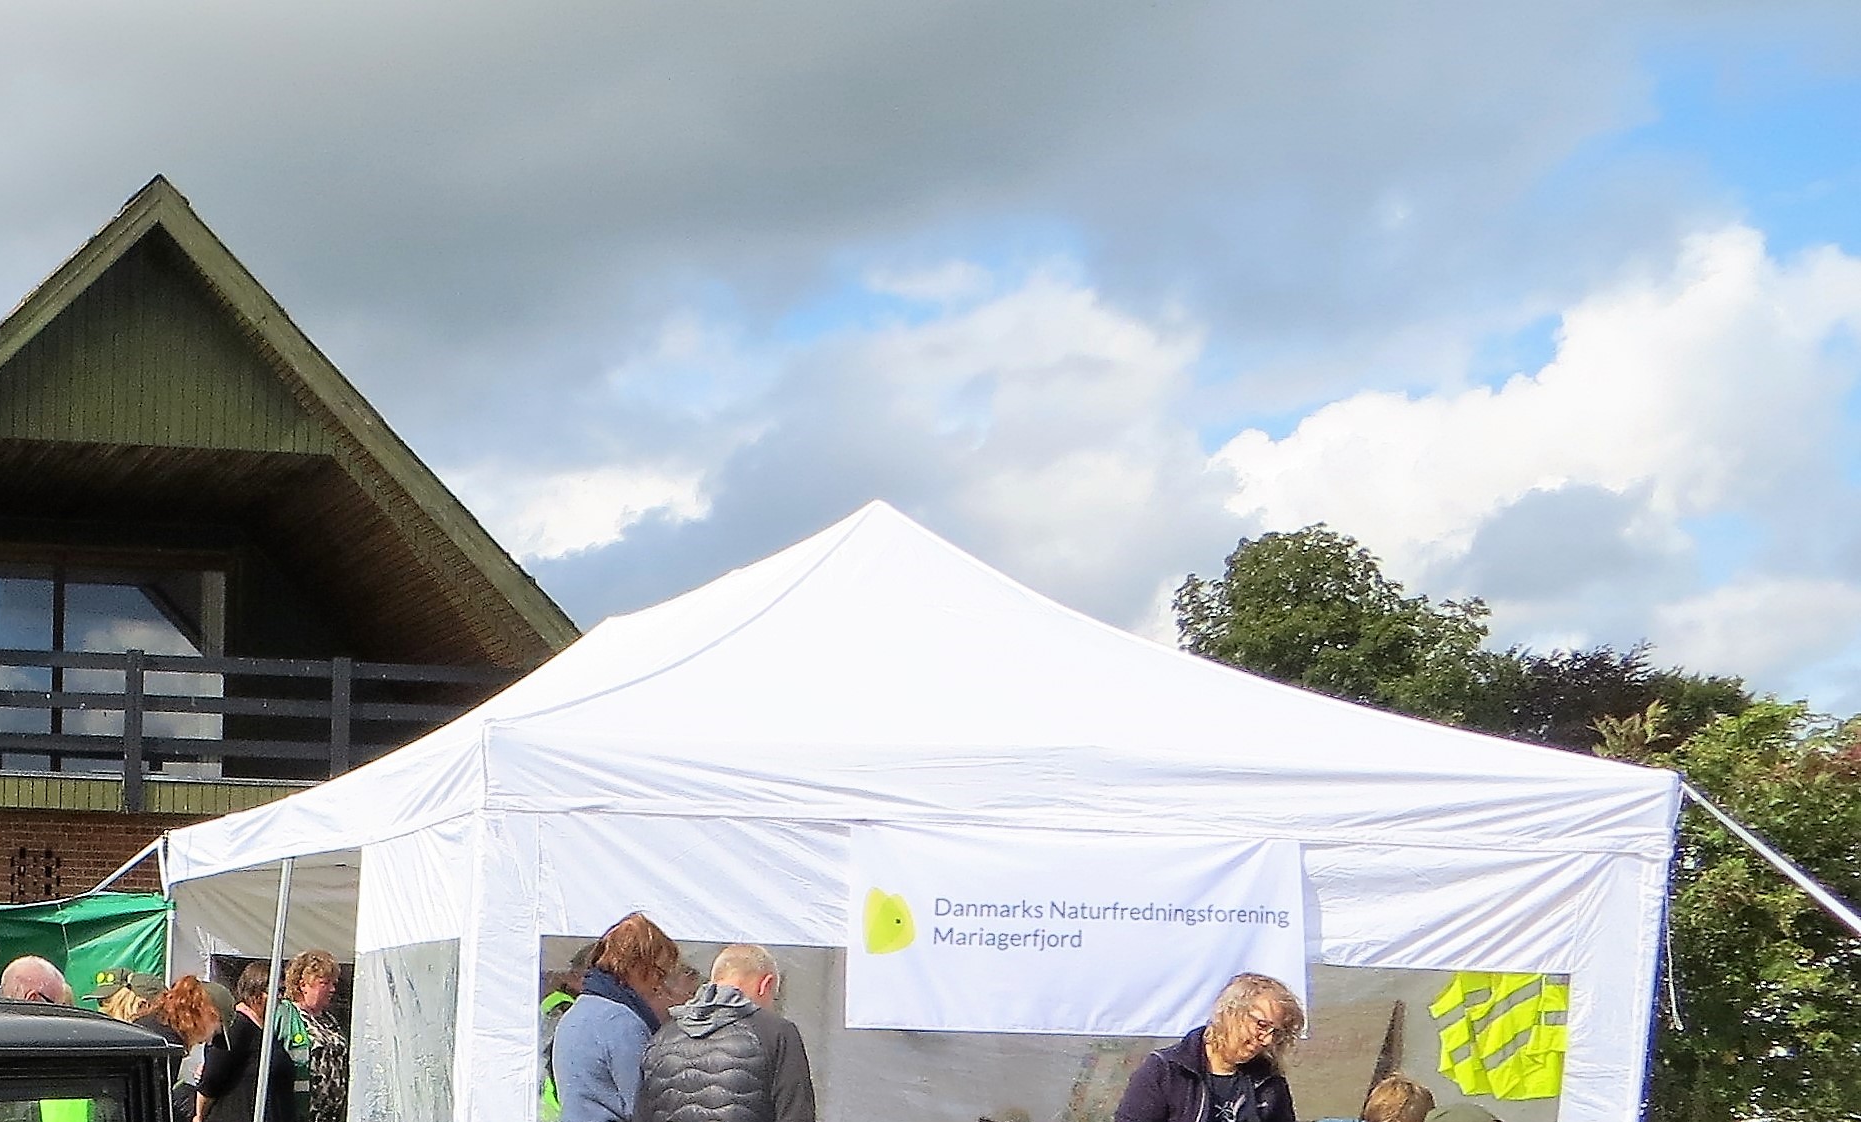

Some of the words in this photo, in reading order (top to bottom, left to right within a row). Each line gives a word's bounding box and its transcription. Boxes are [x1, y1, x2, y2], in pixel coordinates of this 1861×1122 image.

[934, 897, 1044, 921] Danmarks
[1050, 899, 1290, 926] Naturfredningsforening
[934, 927, 1082, 951] Mariagerfjord
